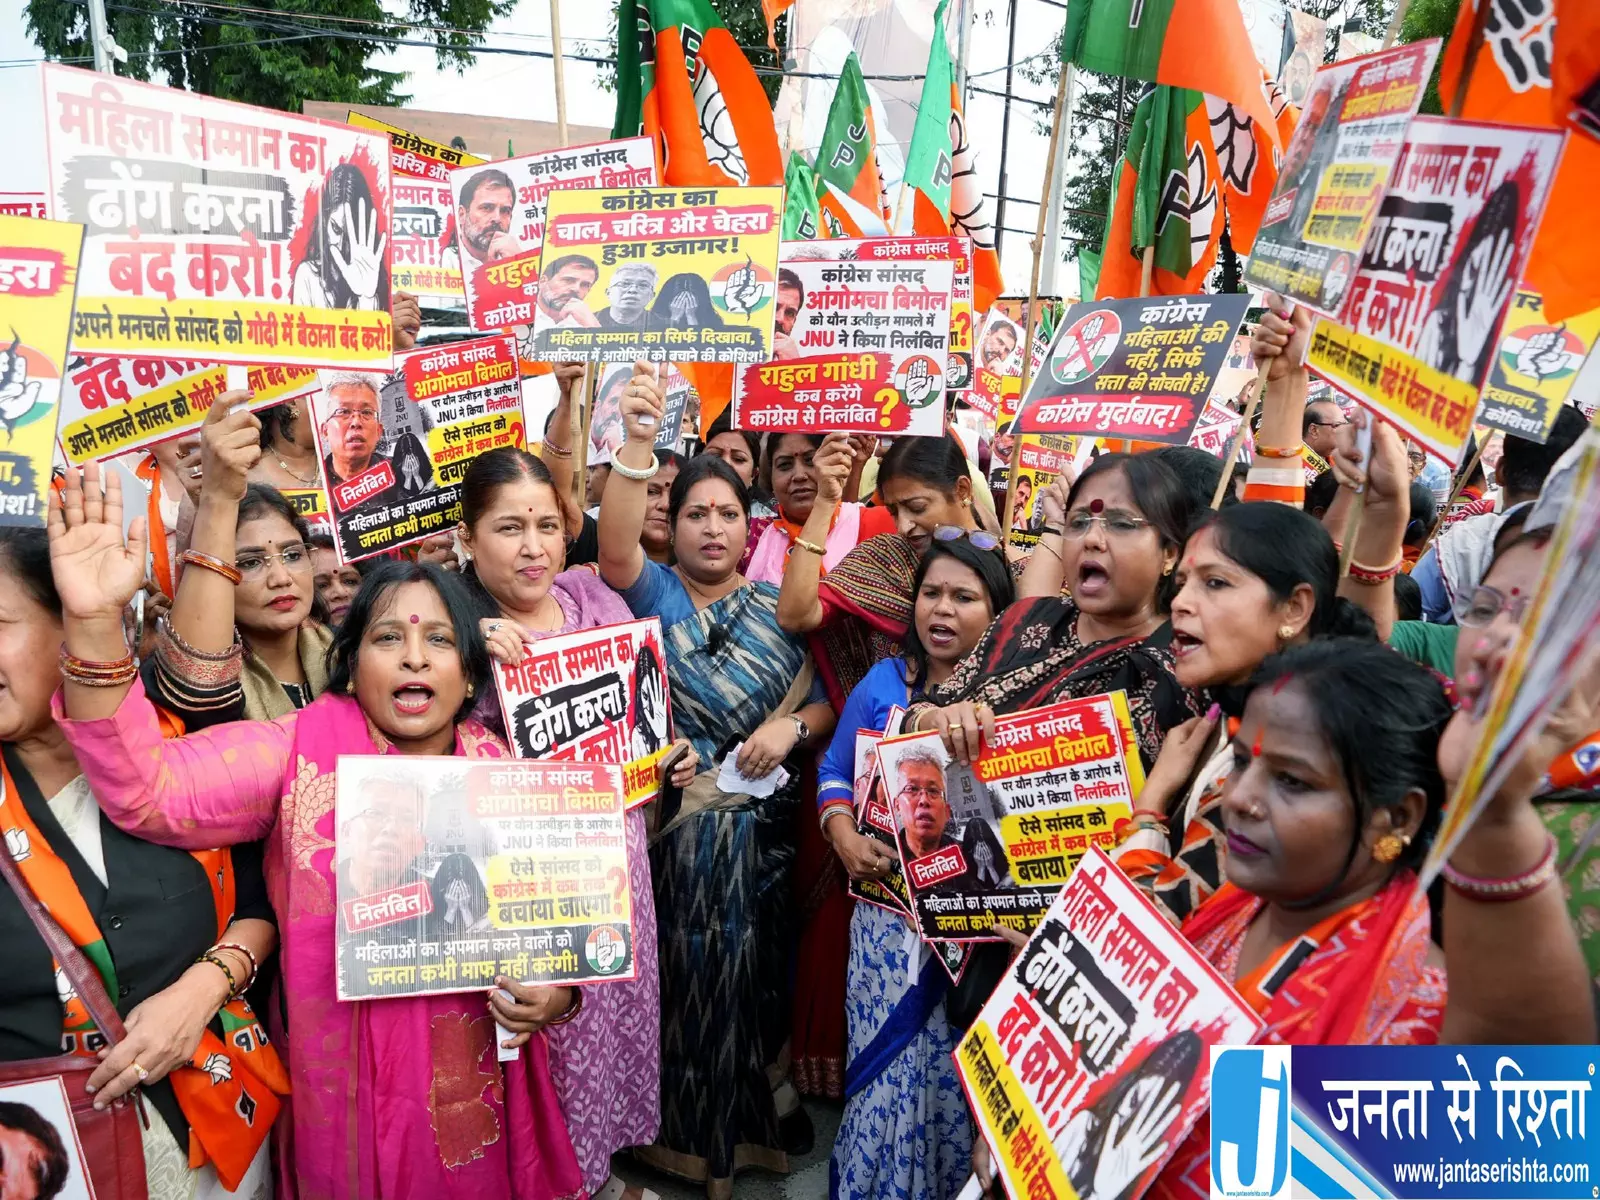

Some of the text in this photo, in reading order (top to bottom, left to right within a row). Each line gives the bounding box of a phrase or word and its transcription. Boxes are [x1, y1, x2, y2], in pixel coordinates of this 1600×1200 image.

[57, 82, 326, 175] महिला सम्मान का
[387, 131, 463, 165] कांग्रेस का
[528, 148, 627, 176] कांग्रेस सांसद
[85, 161, 284, 234] ढोंग करना
[602, 189, 717, 210] कांग्रेस का
[525, 205, 538, 219] को
[557, 208, 768, 240] चाल, चरित्र और चेहरा
[602, 237, 738, 265] हुआ उजागर!
[874, 240, 949, 257] कांग्रेस सांसद
[1383, 216, 1449, 273] करना
[107, 225, 282, 302] बंद करो!
[822, 264, 926, 283] कांग्रेस सांसद
[402, 272, 412, 288] को
[415, 271, 432, 288] गोदी
[806, 285, 948, 310] आंगोमचा बिमोल
[483, 301, 530, 327] कांग्रेस
[810, 312, 935, 328] को यौन उत्पीड़न मामले में
[1140, 299, 1210, 324] कांग्रेस
[75, 304, 358, 350] अपने मनचले सांसद को गोदी बैठाना बंद
[551, 329, 755, 346] महिला सम्मान का सिर्फ दिखावा,
[800, 330, 945, 350] JNU ने किया निलंबित
[1124, 320, 1229, 348] महिलाओं की
[422, 345, 496, 372] कांग्रेस सांसद
[539, 350, 587, 361] असलियत
[602, 346, 649, 361] आरोपियों
[652, 346, 665, 361] को
[669, 347, 697, 361] बचाने
[701, 348, 715, 361] की
[719, 347, 763, 363] कोशिश!
[1126, 346, 1205, 371] नहीं, सिर्फ
[414, 361, 512, 398] आंगोमचा बिमोल
[760, 355, 878, 391] राहुल गांधी
[1095, 371, 1209, 394] सत्ता की सोचती है!
[794, 386, 862, 403] कब करेंगे
[68, 430, 95, 456] अपने
[99, 409, 135, 444] मनचले
[138, 403, 171, 433] सांसद
[173, 390, 189, 420] को
[188, 379, 215, 411] गोदी
[437, 407, 456, 423] JNU
[750, 405, 877, 427] कांग्रेस से निलंबित
[1036, 397, 1096, 425] कांग्रेस
[1096, 395, 1181, 429] मुर्दाबाद!
[1484, 407, 1544, 434] कोशिश!
[464, 420, 491, 439] सांसद
[341, 472, 388, 504] निलंबित
[348, 497, 436, 532] महिलाओं अपमान
[359, 524, 392, 550] जनता
[563, 638, 614, 679] सम्मान
[615, 633, 635, 662] का
[525, 682, 622, 751] ढोंग करना
[1038, 712, 1082, 740] सांसद
[979, 732, 1110, 780] आंगोमचा बिमोल
[1002, 766, 1111, 792] पर यौन उत्पीड़न के आरोप
[1010, 783, 1126, 810] JNU ने किया निलंबित!
[1020, 807, 1106, 836] ऐसे सांसद को
[1009, 831, 1087, 859] कांग्रेस में कब
[914, 855, 959, 882] निलंबित
[1016, 854, 1066, 882] बचाया
[353, 891, 421, 925] निलंबित
[924, 892, 1041, 912] महिलाओं का अपमान करने
[936, 913, 968, 932] जनता
[356, 938, 488, 961] महिलाओं का अपमान
[1064, 866, 1199, 1035] महिला सम्मान का
[368, 966, 415, 987] जनता
[1025, 932, 1128, 1068] ढोंग करना
[998, 988, 1040, 1066] बंद
[1021, 1023, 1088, 1130] करो!
